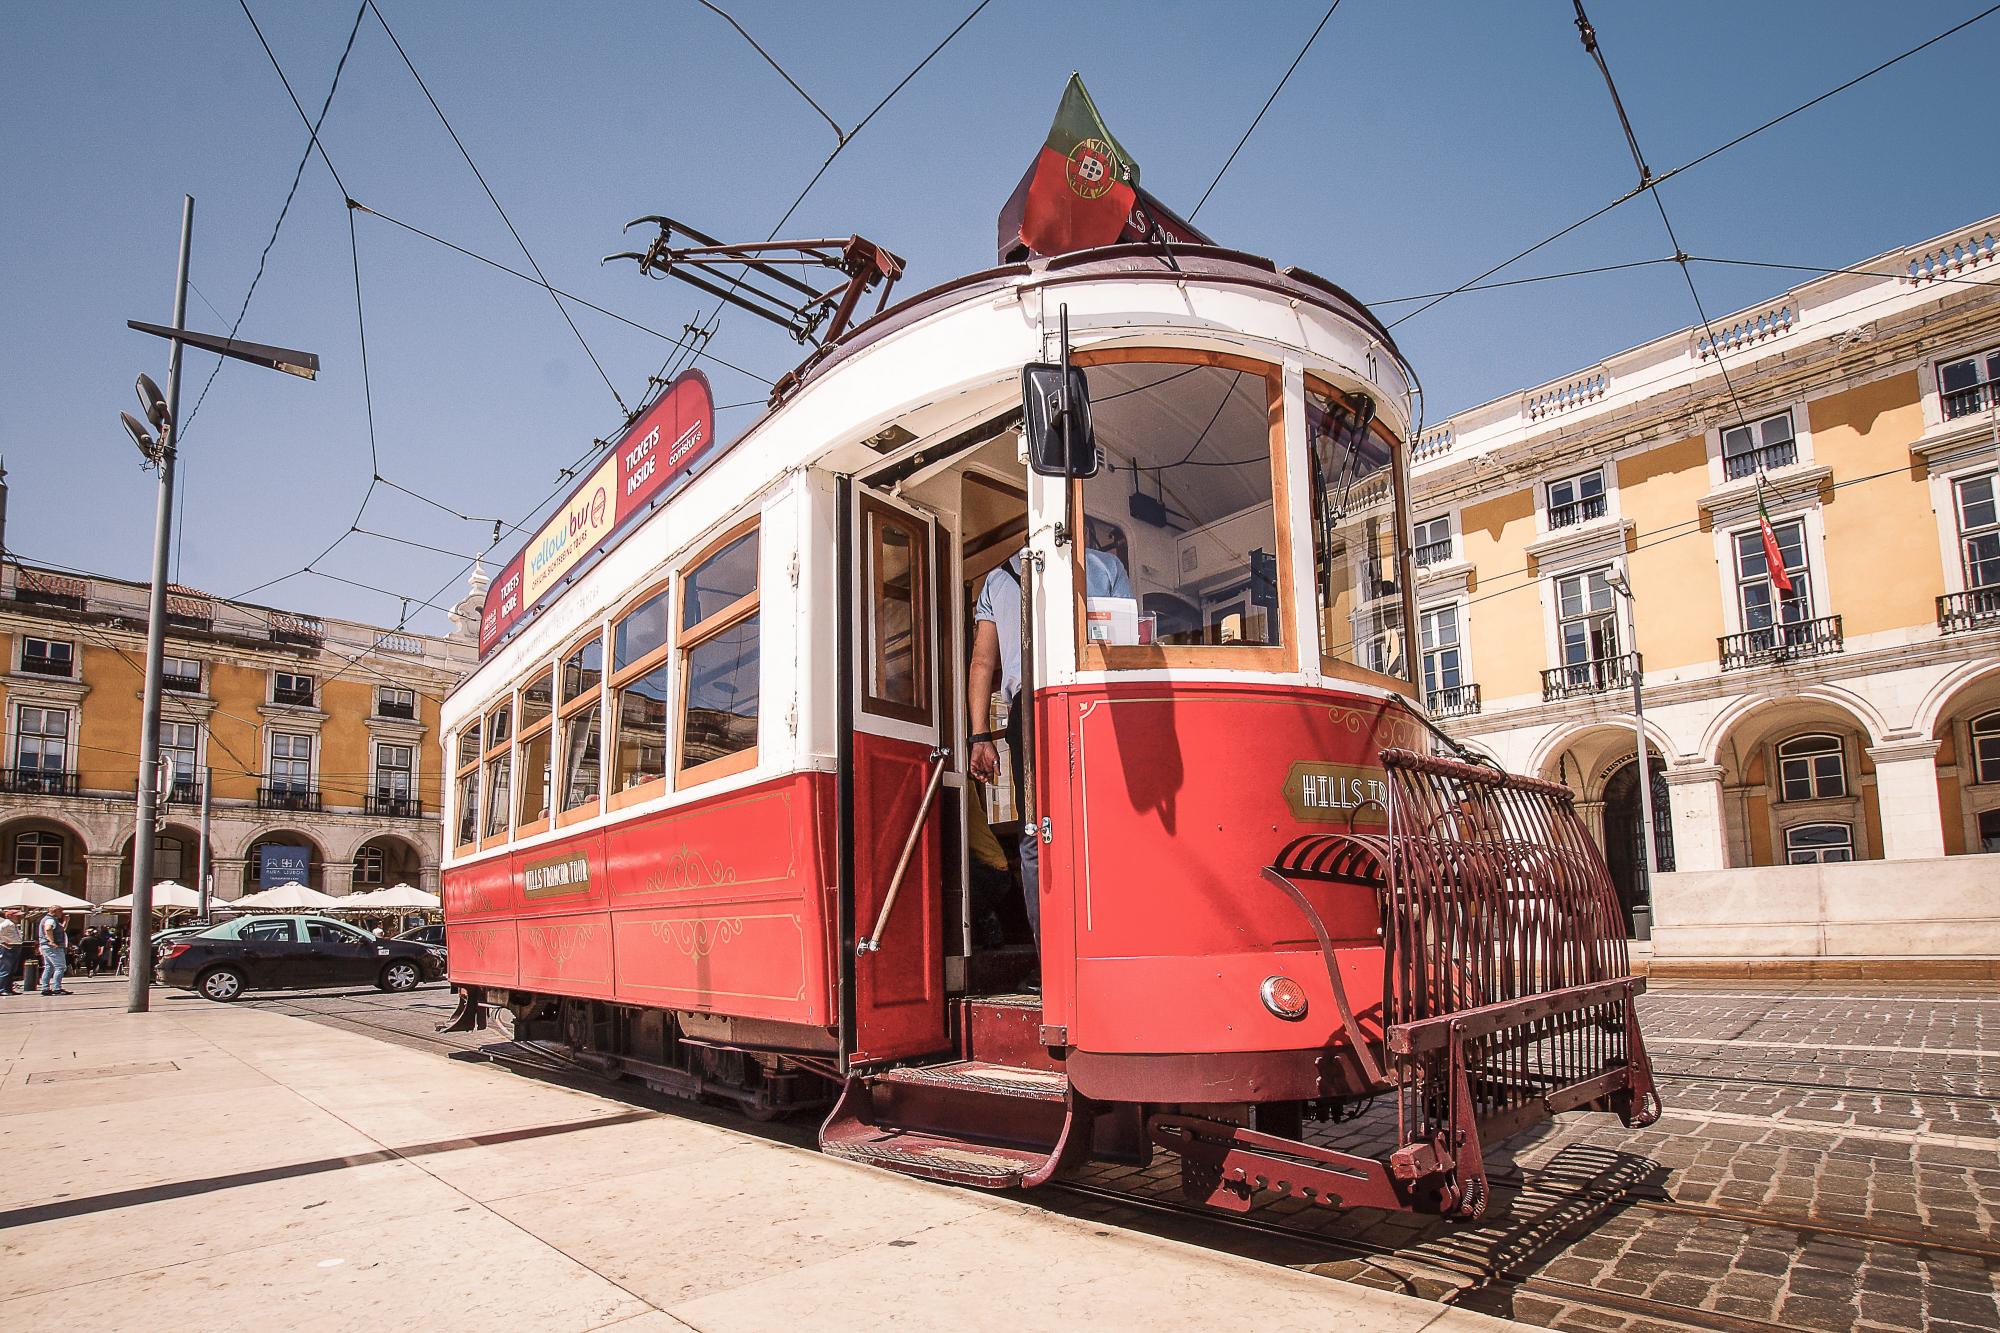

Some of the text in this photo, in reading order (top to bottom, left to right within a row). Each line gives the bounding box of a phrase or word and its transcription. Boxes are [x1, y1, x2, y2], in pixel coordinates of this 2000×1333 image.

[1366, 353, 1377, 384] 11
[625, 424, 660, 472] TICKETS
[627, 454, 656, 496] INSIDE
[531, 502, 590, 576] yellow bus
[500, 572, 520, 601] TICKETS
[501, 593, 518, 619] INSIDE
[1600, 751, 1639, 779] MINISTERI
[1302, 774, 1364, 809] HILLS
[525, 859, 588, 891] HILLS TRAMCAR TOUR
